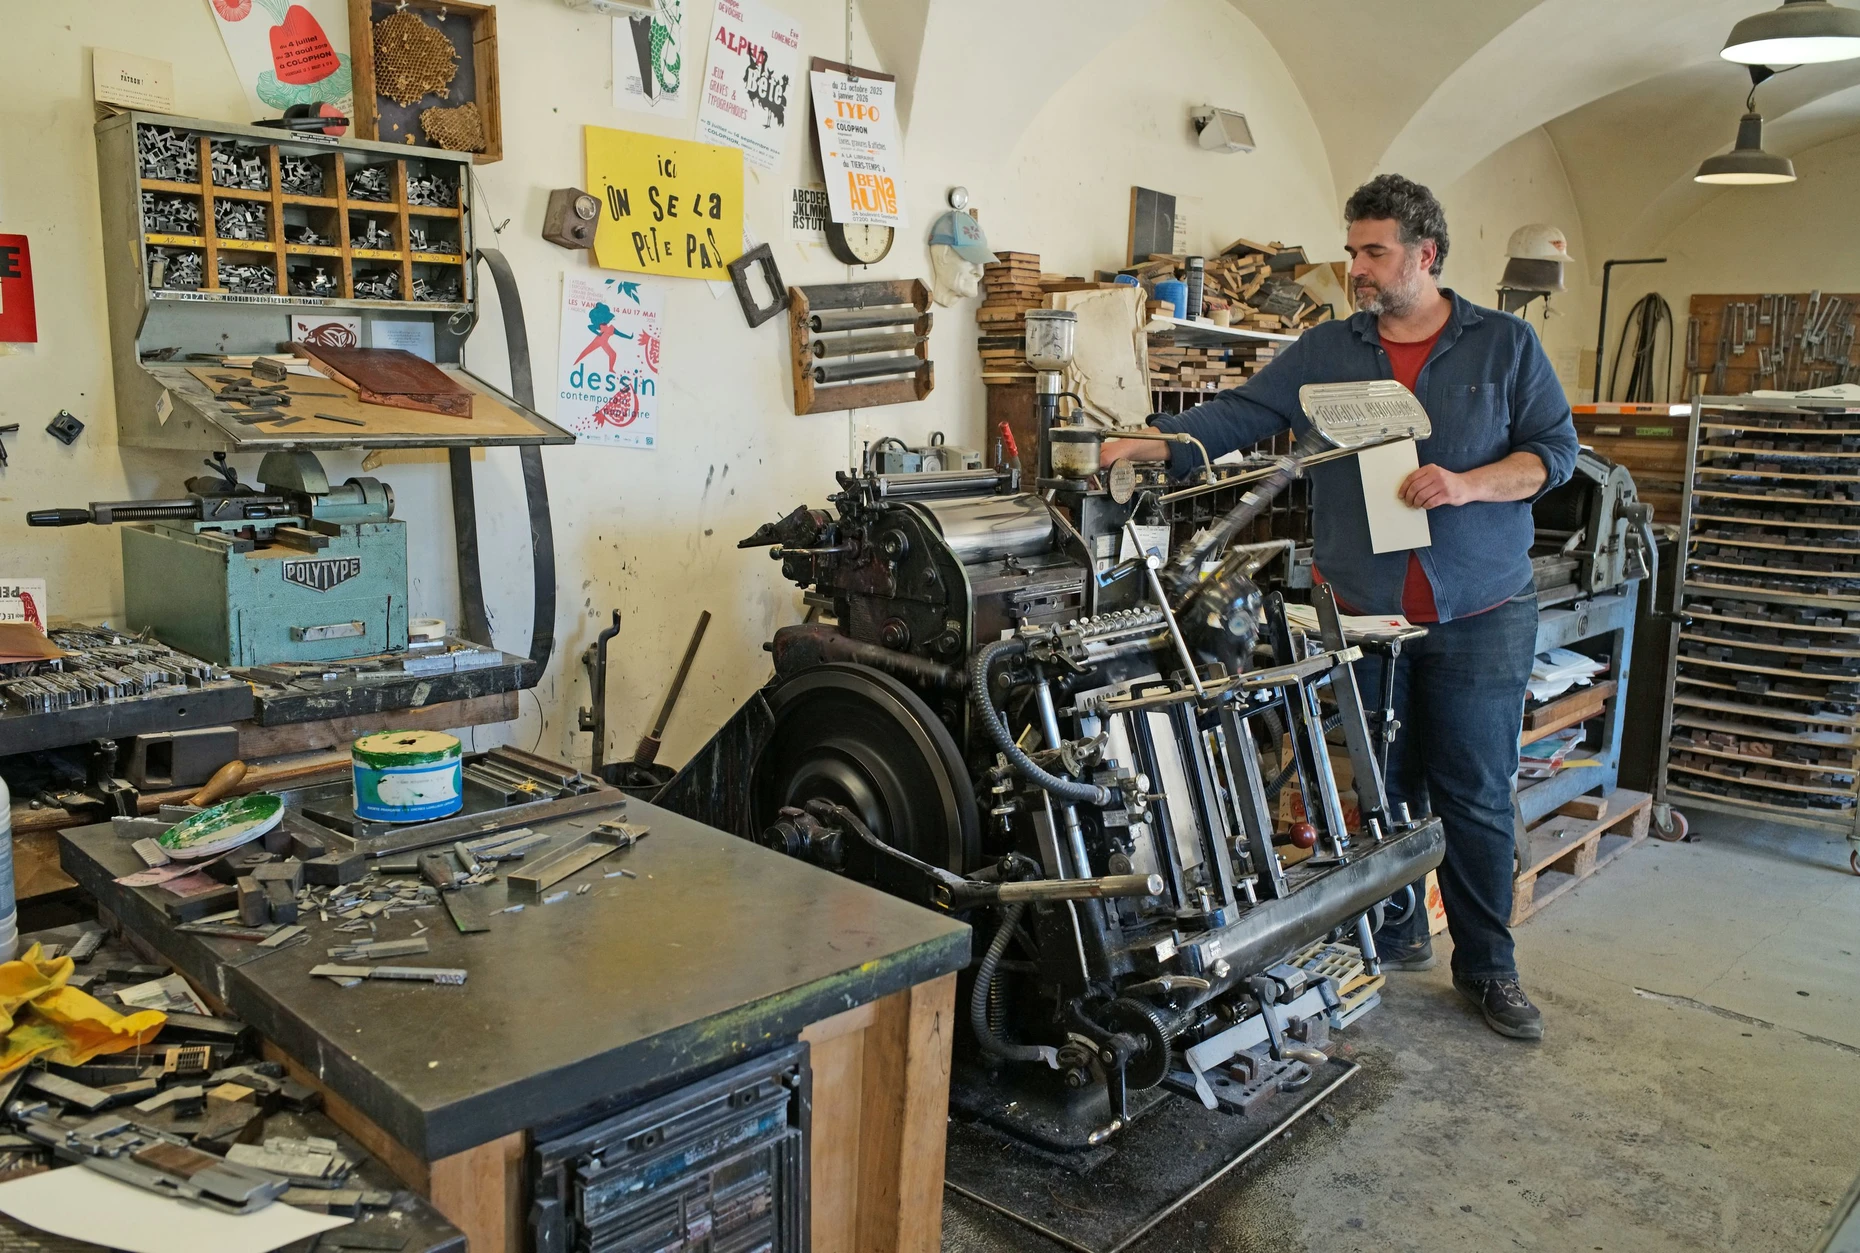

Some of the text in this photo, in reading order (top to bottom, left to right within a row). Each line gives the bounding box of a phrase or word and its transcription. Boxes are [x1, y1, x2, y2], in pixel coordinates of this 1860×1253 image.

[296, 35, 318, 46] juillet
[715, 26, 765, 66] ALPHA
[286, 51, 332, 68] COLOPHON
[731, 90, 736, 100] &
[838, 91, 854, 100] janvier
[856, 94, 869, 102] 2026
[849, 84, 868, 94] octobre
[870, 86, 883, 95] 2025
[834, 100, 880, 122] TYPO
[836, 122, 868, 134] COLOPHON
[657, 154, 677, 178] ici
[607, 185, 631, 221] ON
[648, 186, 679, 222] SE
[687, 228, 723, 269] PAS
[569, 363, 655, 396] dessin
[286, 560, 359, 589] POLYTYPE
